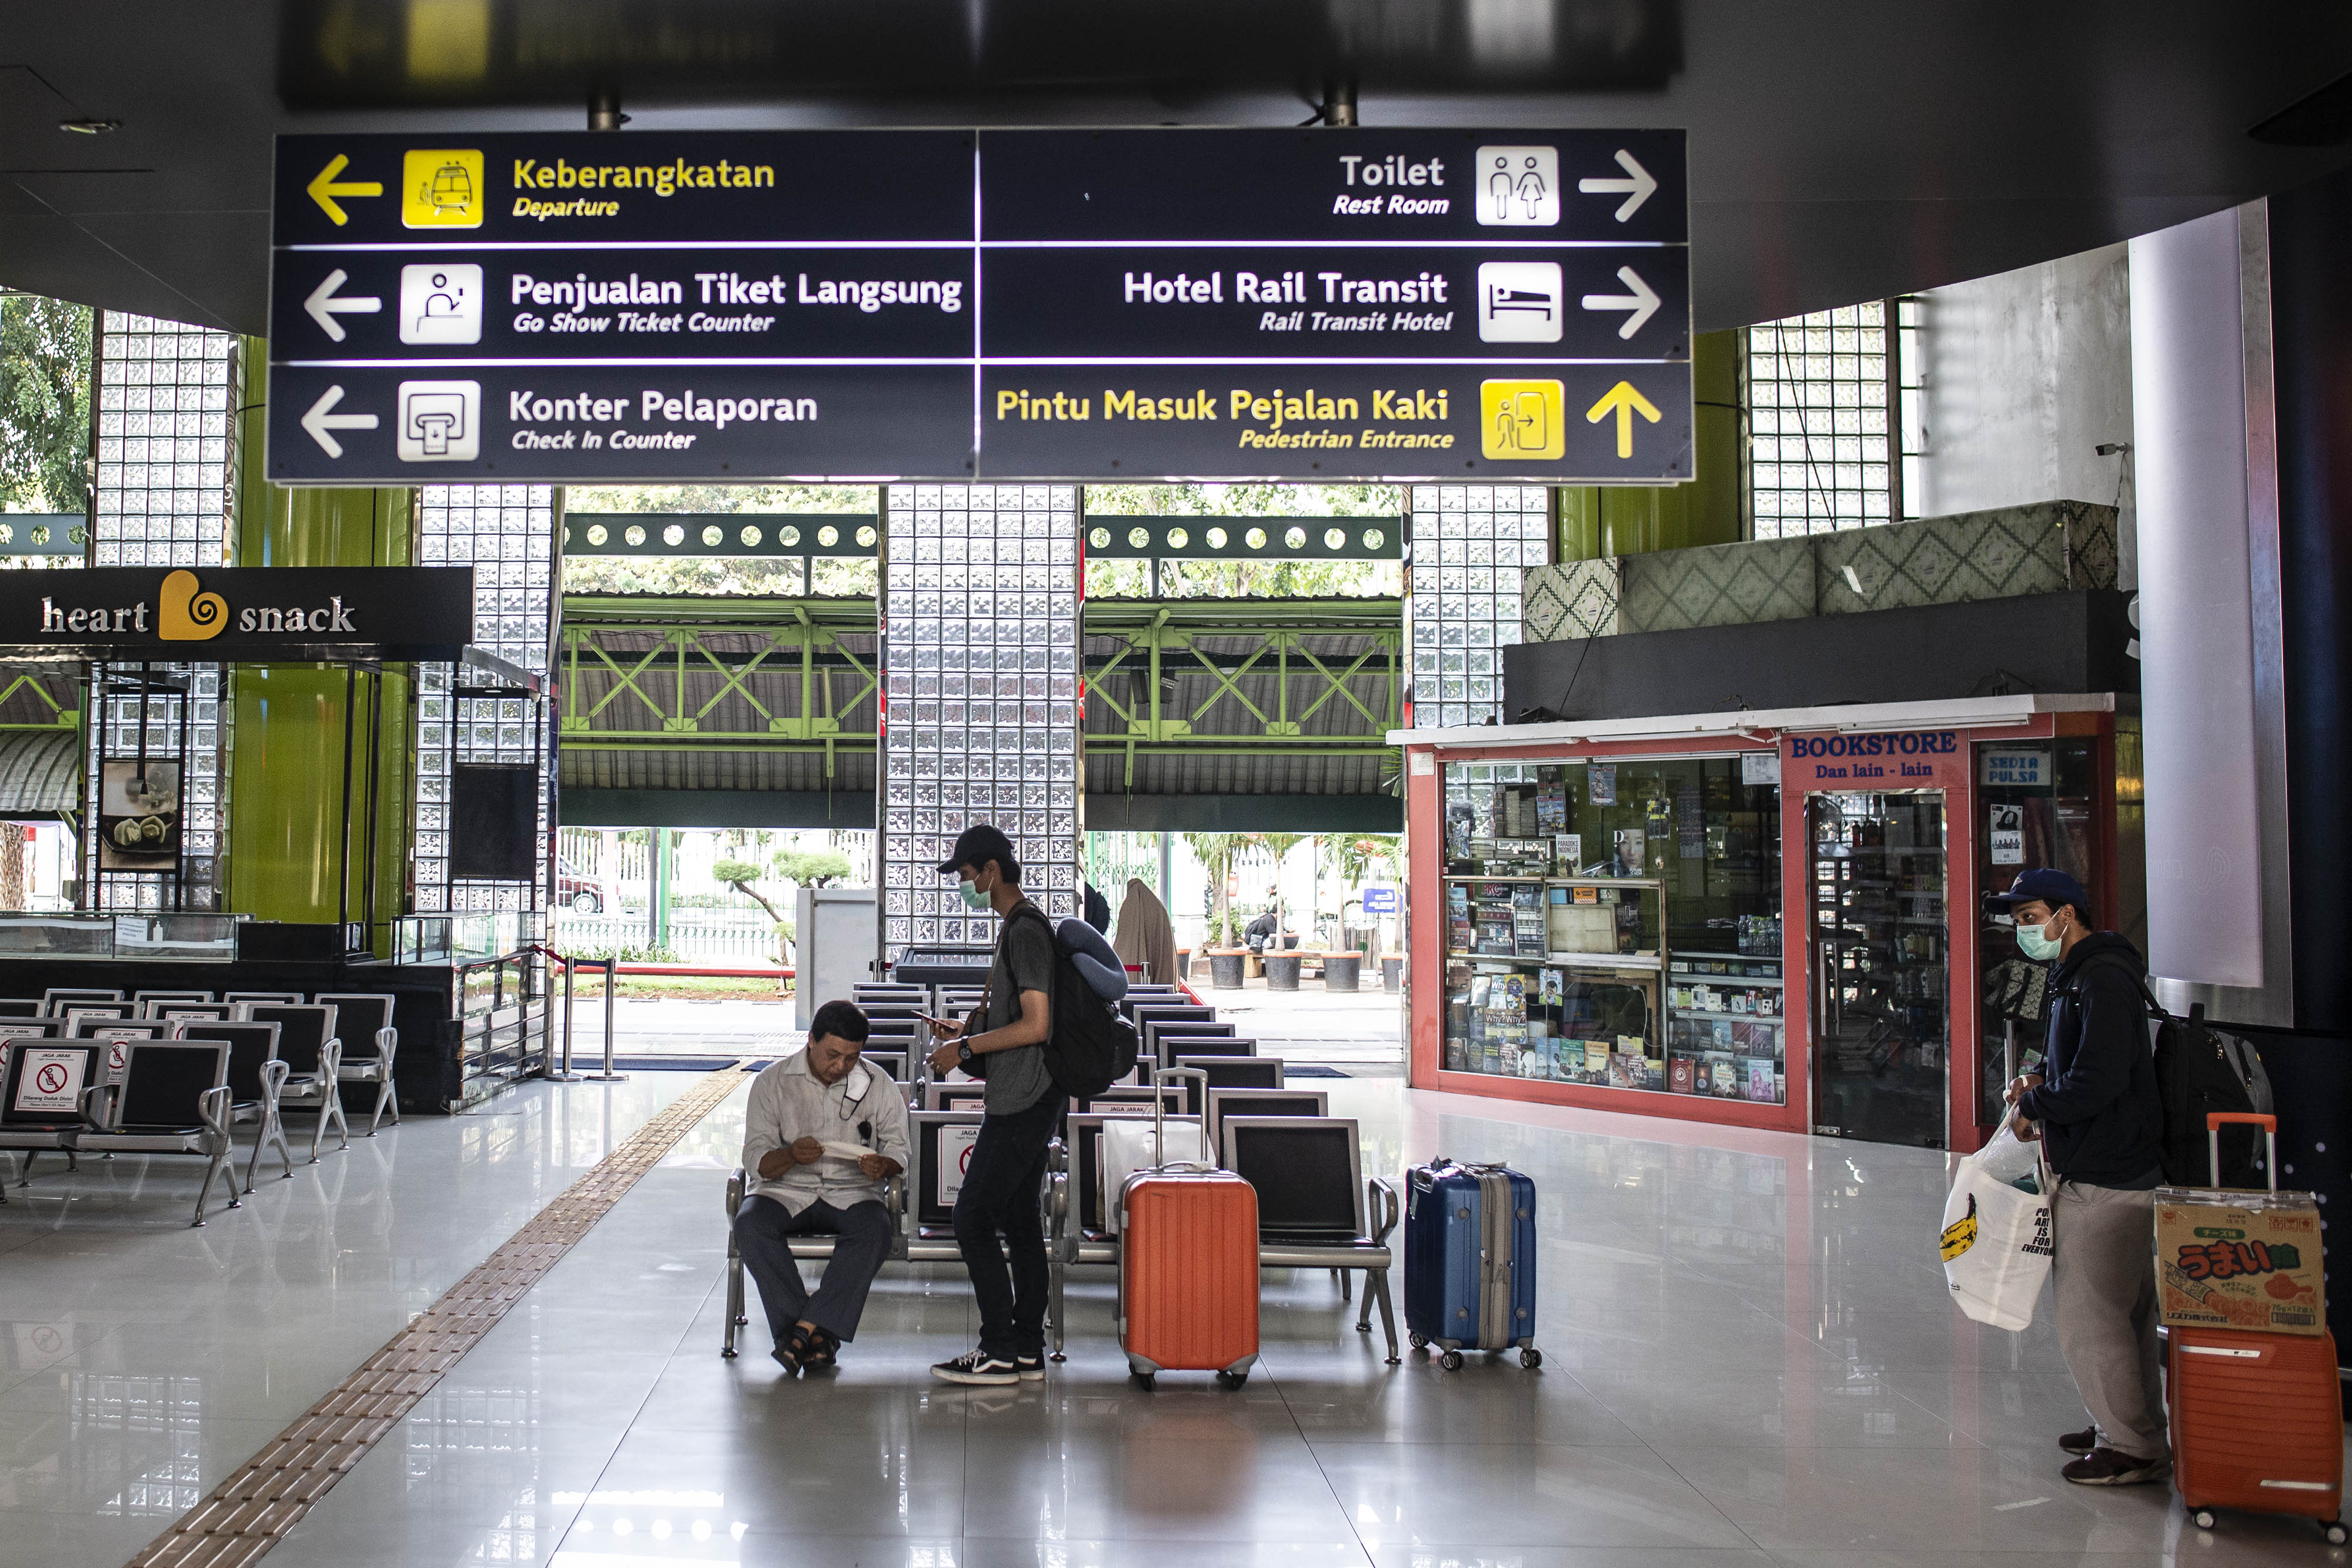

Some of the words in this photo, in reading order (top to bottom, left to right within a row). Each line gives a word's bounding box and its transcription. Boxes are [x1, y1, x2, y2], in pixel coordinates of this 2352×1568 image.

[514, 158, 774, 196] Keberangkatan
[1339, 155, 1444, 186] Toilet
[513, 198, 619, 221] Departure
[1332, 195, 1383, 215] Rest
[1387, 195, 1449, 215] Room
[512, 273, 683, 312] Penjualan
[694, 273, 786, 305] Tiket
[798, 274, 963, 313] Langsung
[1124, 272, 1224, 303] Hotel
[1235, 272, 1306, 303] Rail
[1317, 272, 1448, 303] Transit
[513, 312, 545, 333] Go
[550, 312, 611, 333] Show
[618, 312, 683, 332] Ticket
[689, 312, 775, 332] Counter
[1259, 312, 1304, 331] Rail
[1311, 312, 1388, 331] Transit
[1392, 312, 1454, 332] Hotel
[510, 390, 630, 422] Konter
[642, 390, 817, 429] Pelaporan
[997, 389, 1090, 421] Pintu
[1104, 389, 1217, 421] Masuk
[1231, 389, 1359, 430] Pejalan
[1373, 389, 1448, 420] Kaki
[512, 430, 576, 450] Check
[582, 430, 603, 449] In
[609, 430, 697, 450] Counter
[1239, 429, 1353, 449] Pedestrian
[1359, 430, 1455, 450] Entrance
[41, 596, 149, 633] heart
[240, 596, 356, 633] snack
[1792, 732, 1957, 758] BOOKSTORE
[1816, 764, 1846, 778] Dan
[1853, 764, 1884, 777] lain
[1901, 763, 1933, 776] lain
[1989, 757, 2038, 768] SEDIA
[1989, 771, 2038, 783] PULSA
[1485, 1014, 1505, 1024] Why?
[1506, 1014, 1525, 1024] Why?
[2034, 1218, 2050, 1227] ART
[2036, 1227, 2047, 1236] IS
[2022, 1244, 2053, 1256] EVERYON
[2032, 1236, 2050, 1246] FOR
